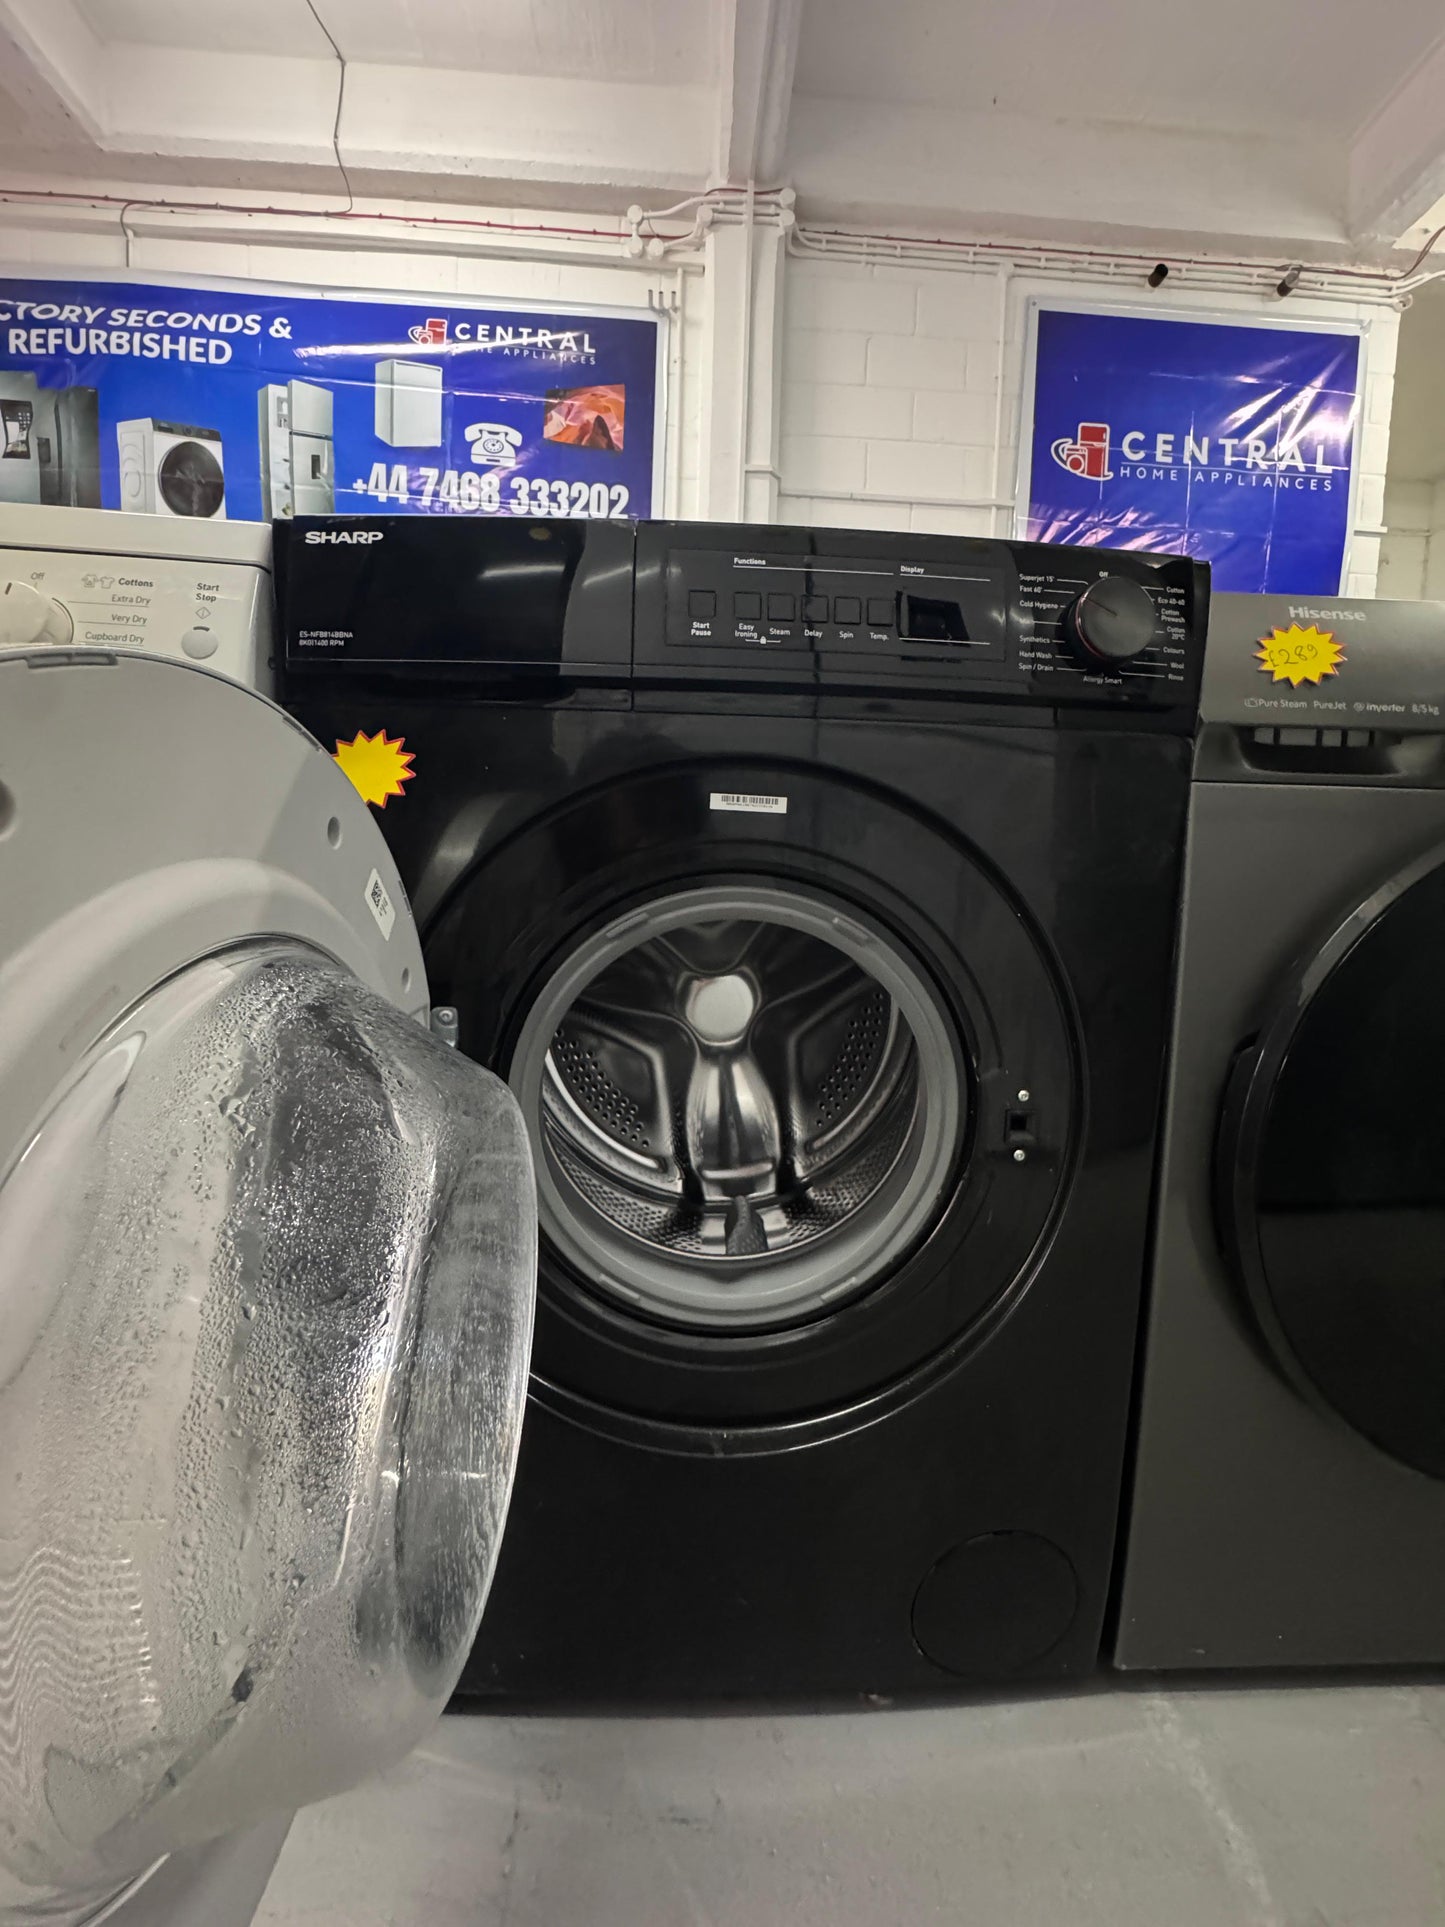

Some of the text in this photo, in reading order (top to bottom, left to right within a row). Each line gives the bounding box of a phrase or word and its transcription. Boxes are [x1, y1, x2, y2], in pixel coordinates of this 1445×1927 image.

[107, 307, 262, 336] SECONDS
[268, 316, 292, 340] &
[455, 322, 596, 353] CENTRAL
[8, 328, 233, 365] REFURBISHED
[503, 347, 596, 366] APPLIANCES
[1121, 430, 1333, 474] CENTRAL
[1120, 465, 1332, 492] HOME APPLIANCES
[353, 462, 630, 519] +44 7468 333202
[304, 531, 384, 544] SHARP
[734, 557, 766, 566] Functions
[900, 565, 925, 575] Display
[30, 571, 45, 581] Off
[118, 577, 154, 588] Cottons
[197, 582, 220, 592] Start
[111, 594, 151, 606] Extra Dry
[196, 593, 217, 604] Stop
[1289, 606, 1367, 621] Hisense
[111, 614, 147, 625] Very Dry
[692, 621, 710, 629] Start
[738, 623, 754, 632] Easy
[690, 628, 712, 636] Pause
[734, 630, 758, 640] Ironing
[769, 627, 791, 636] Steam
[804, 629, 823, 639] Delay
[839, 631, 855, 640] Spin
[85, 631, 145, 645] Cupboard Dry
[870, 632, 889, 642] Temp.
[1019, 650, 1052, 659] Hand Wash
[1269, 644, 1319, 668] £289
[1258, 699, 1307, 709] Pure Steam
[1313, 700, 1346, 710] PureJet
